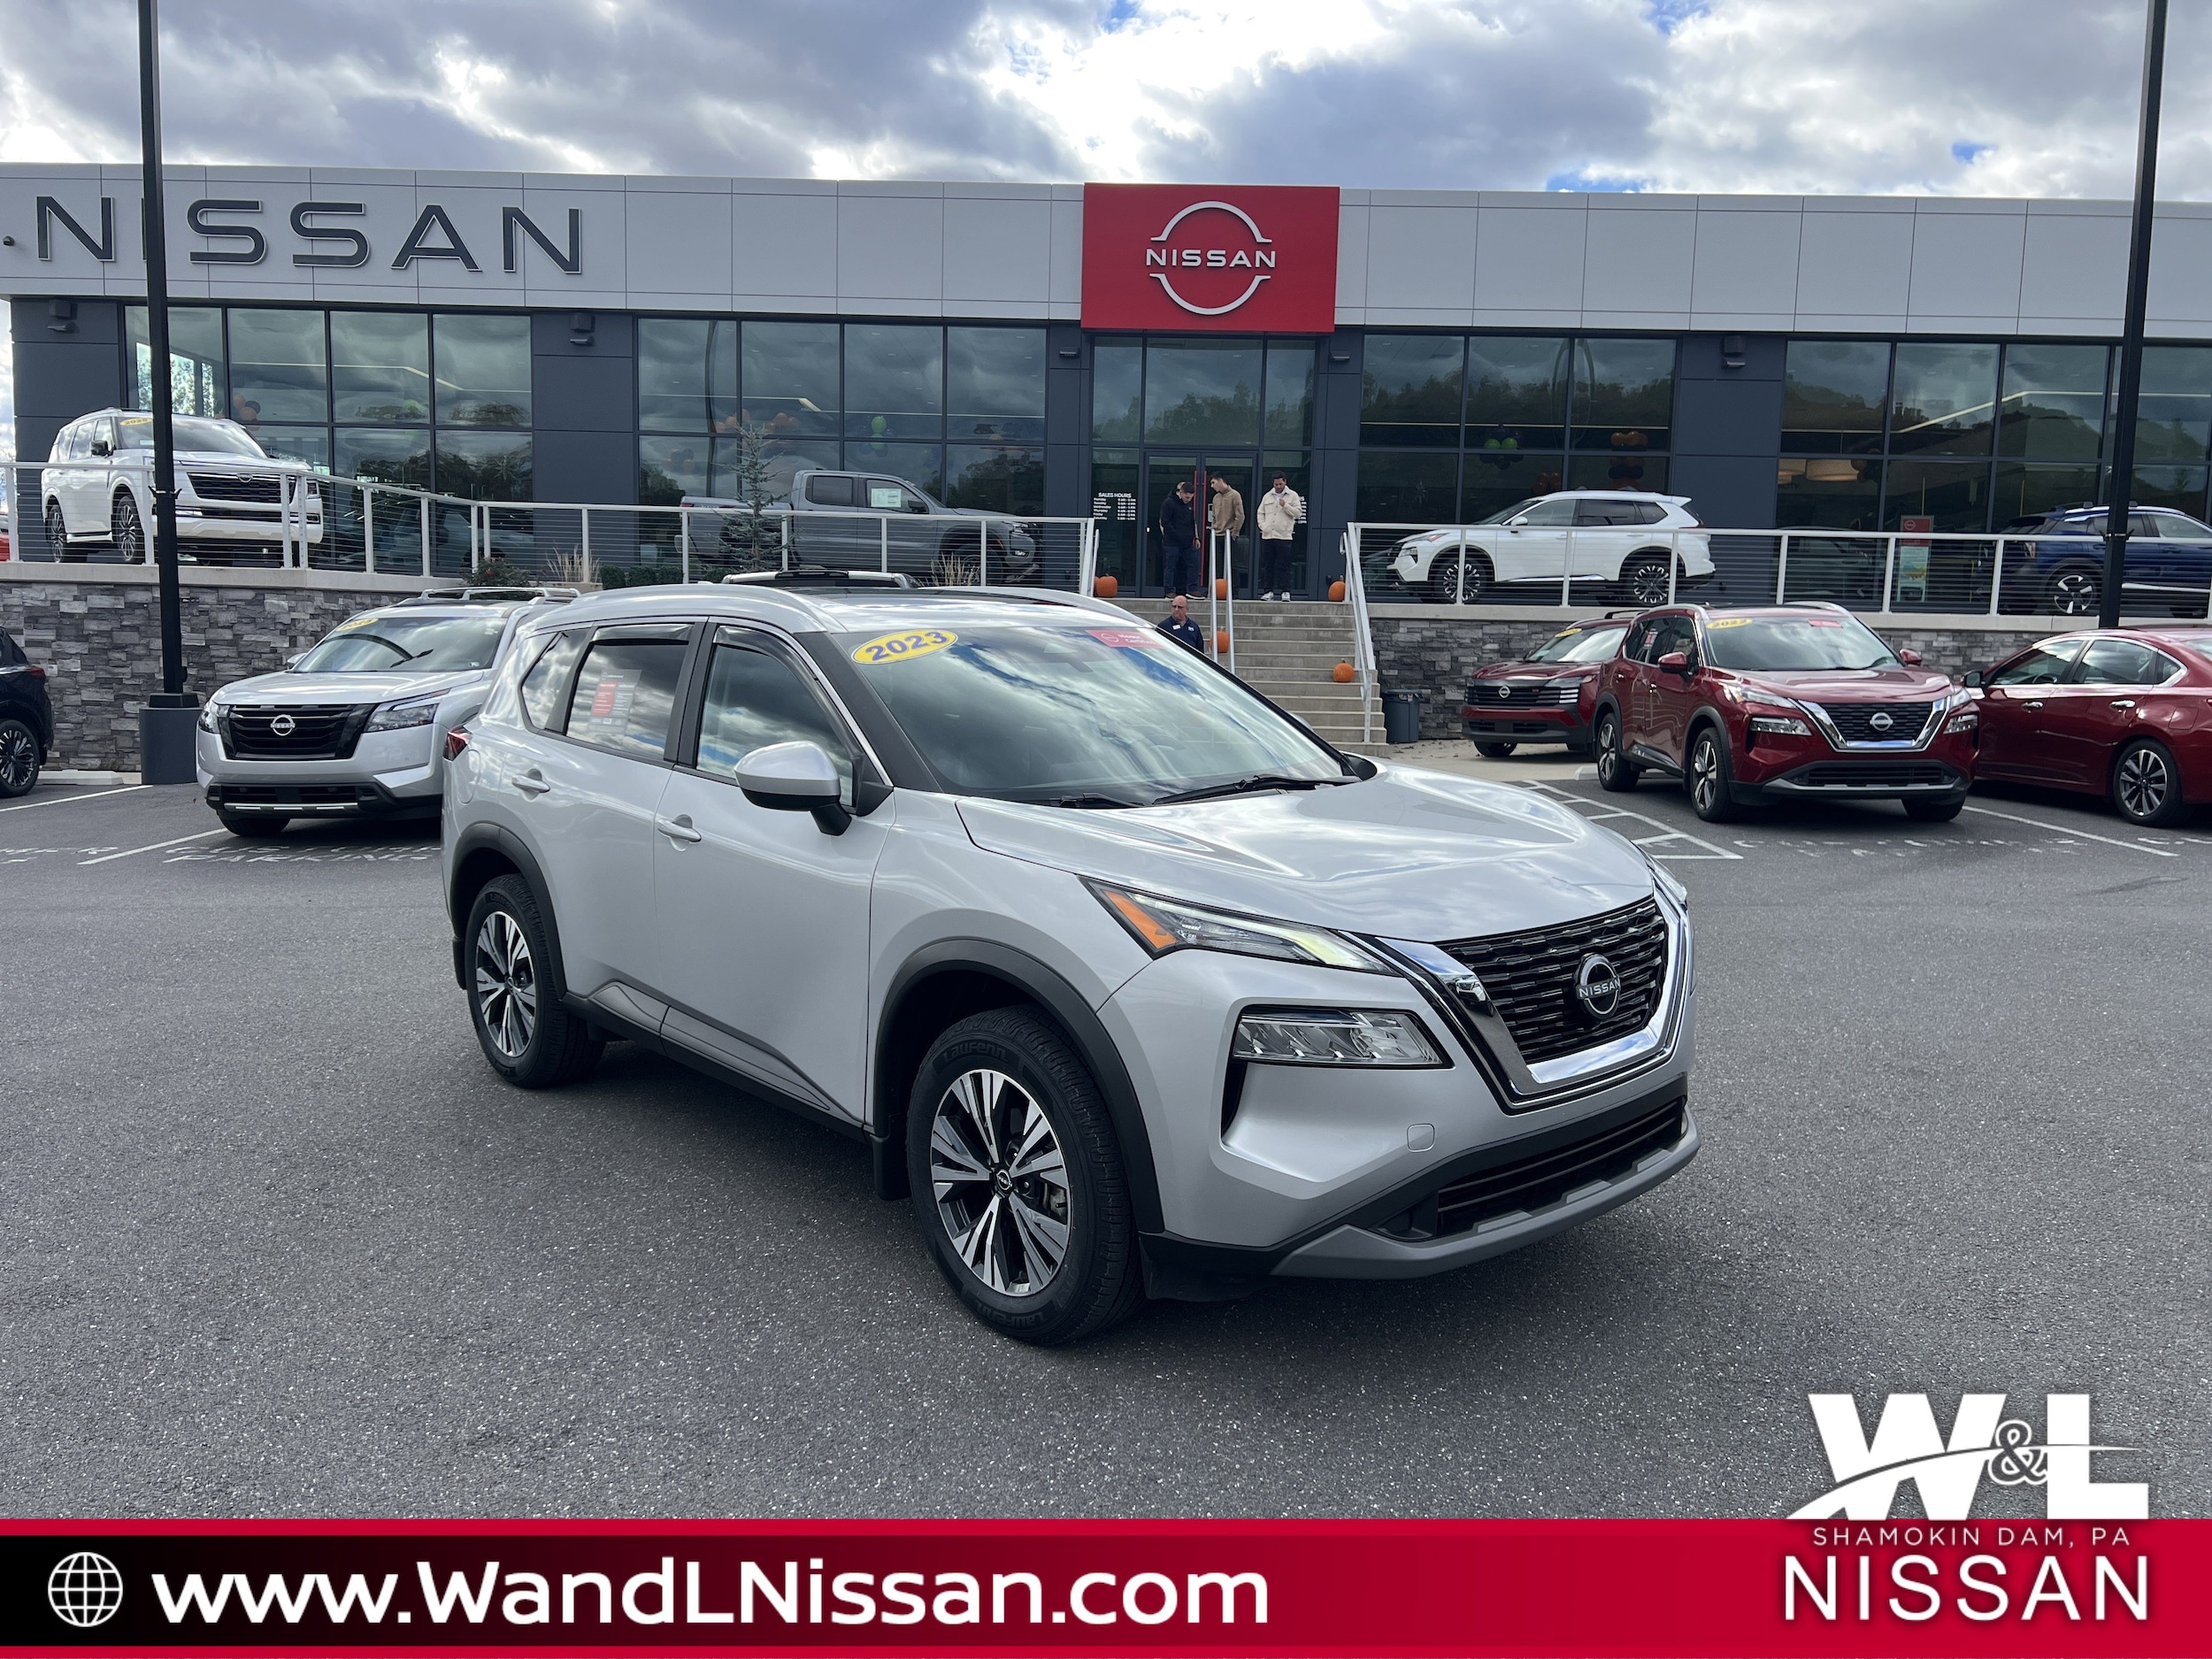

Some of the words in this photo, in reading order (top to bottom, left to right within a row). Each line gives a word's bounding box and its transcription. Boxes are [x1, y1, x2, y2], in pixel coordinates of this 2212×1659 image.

[36, 196, 582, 274] NSSAN
[1146, 249, 1276, 268] NISSAN
[864, 631, 949, 662] 2023
[1578, 979, 1621, 998] NISSAN
